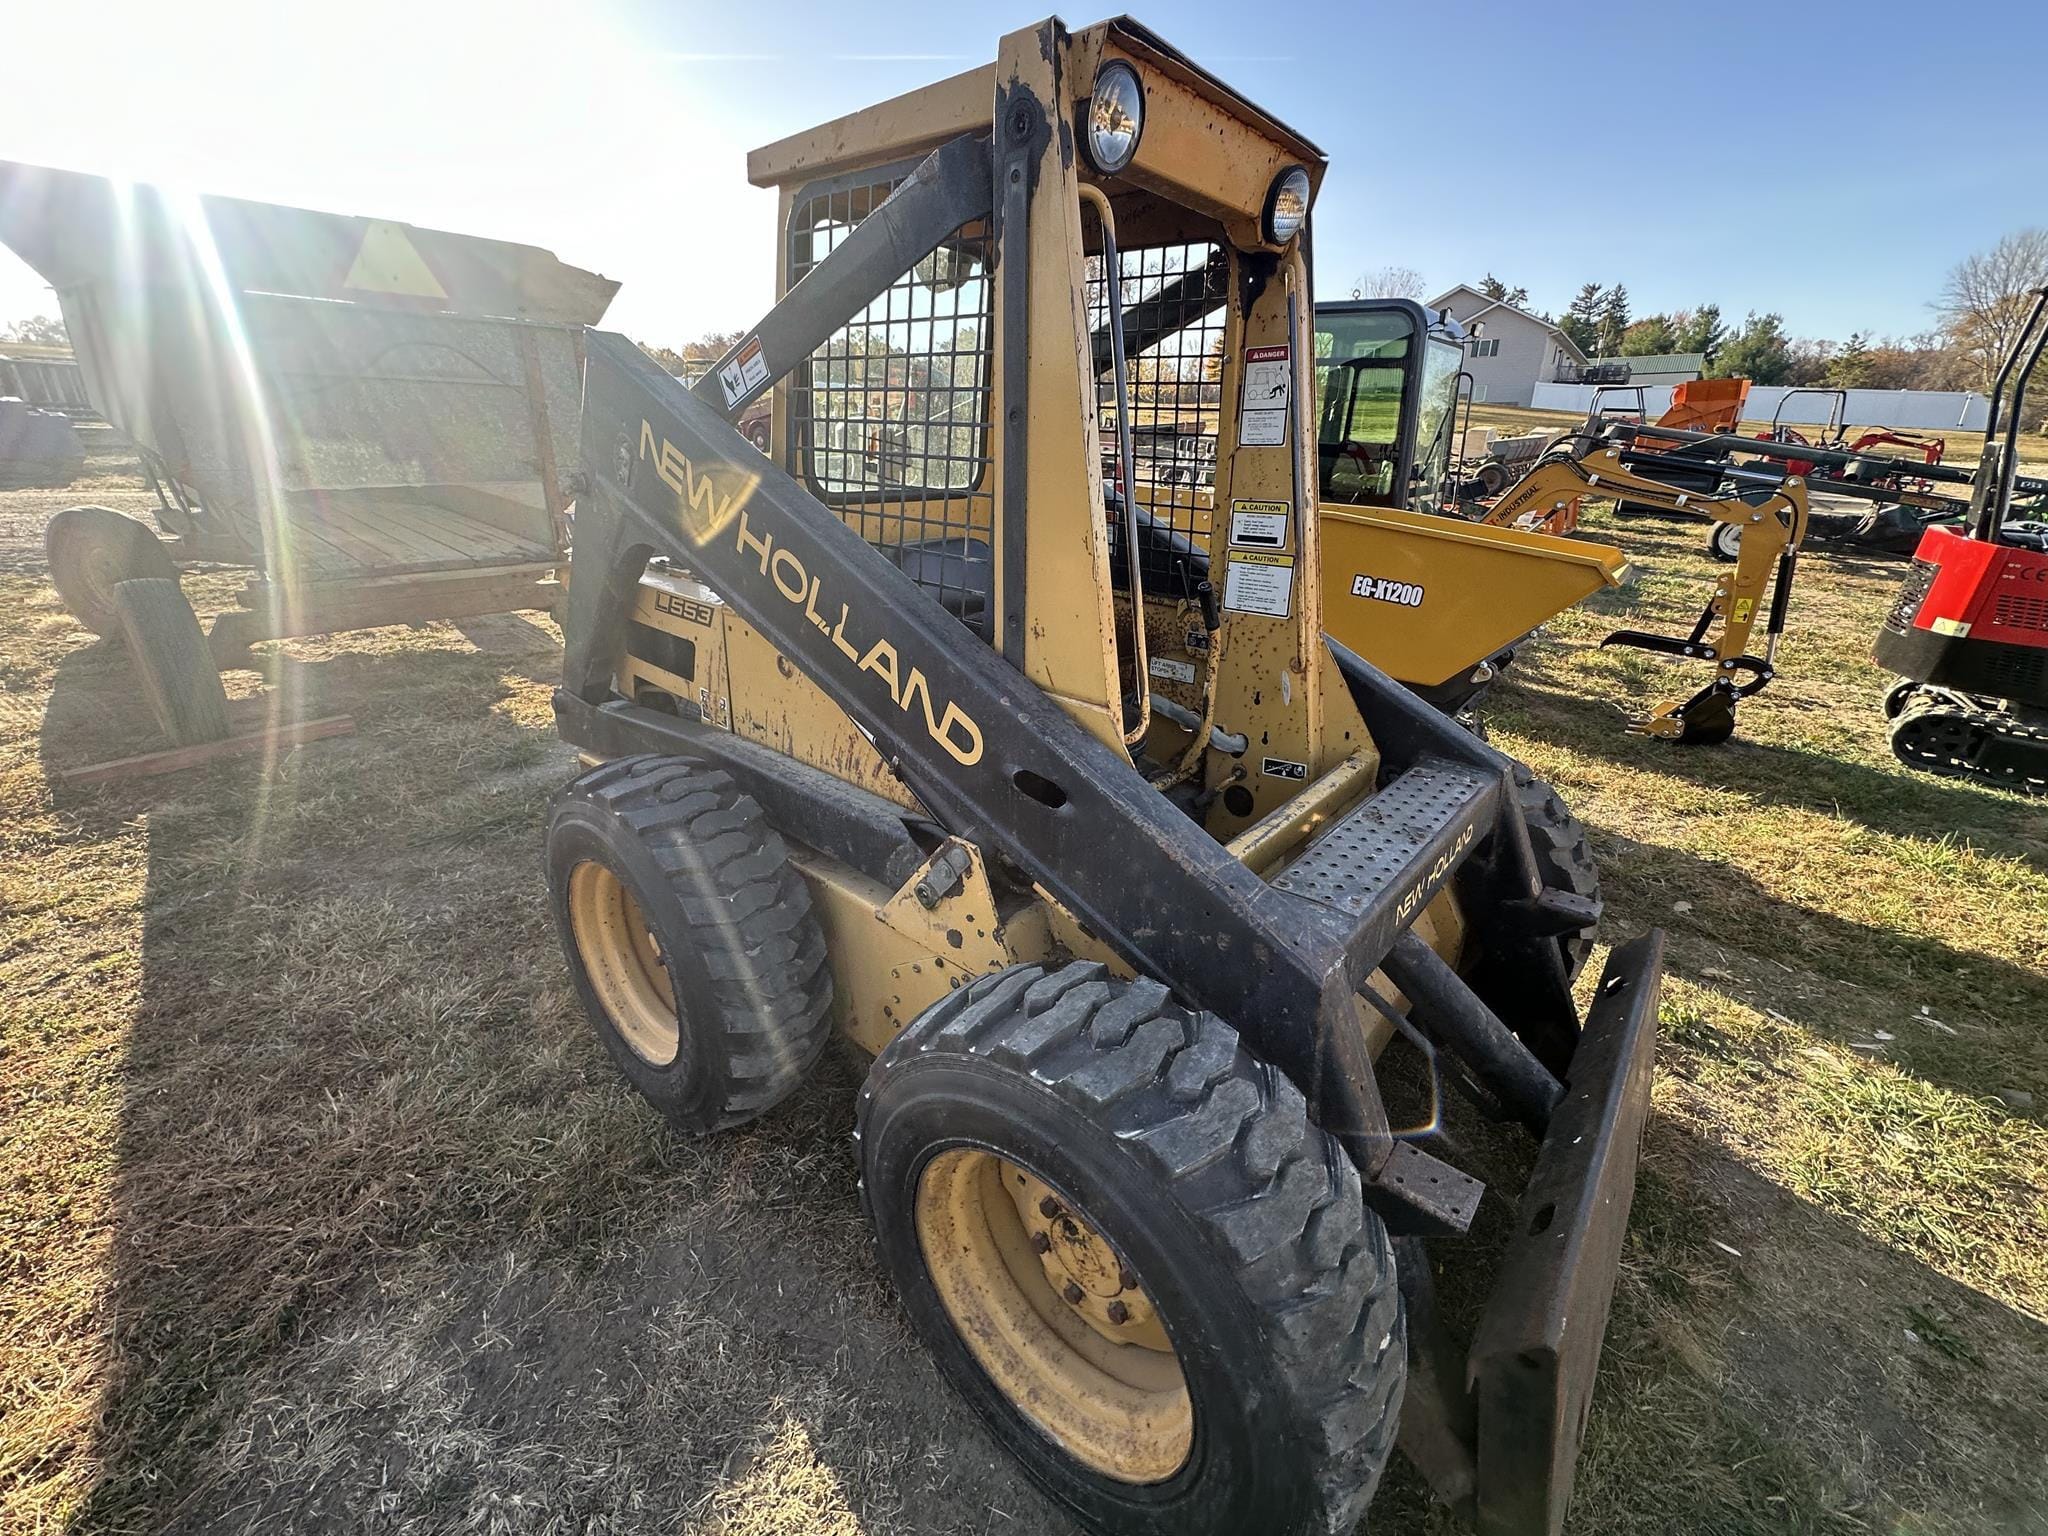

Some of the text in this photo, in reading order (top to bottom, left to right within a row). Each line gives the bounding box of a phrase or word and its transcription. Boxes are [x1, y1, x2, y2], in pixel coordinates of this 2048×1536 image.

[1259, 350, 1285, 359] DANGER
[1249, 504, 1281, 512] CAUTION
[1498, 484, 1539, 520] INDUSTRIAL
[1249, 555, 1280, 563] CAUTION
[640, 418, 983, 767] NEW HOLLAND
[1352, 575, 1424, 607] EG-X1200
[1395, 823, 1474, 926] NEW HOLLAND
